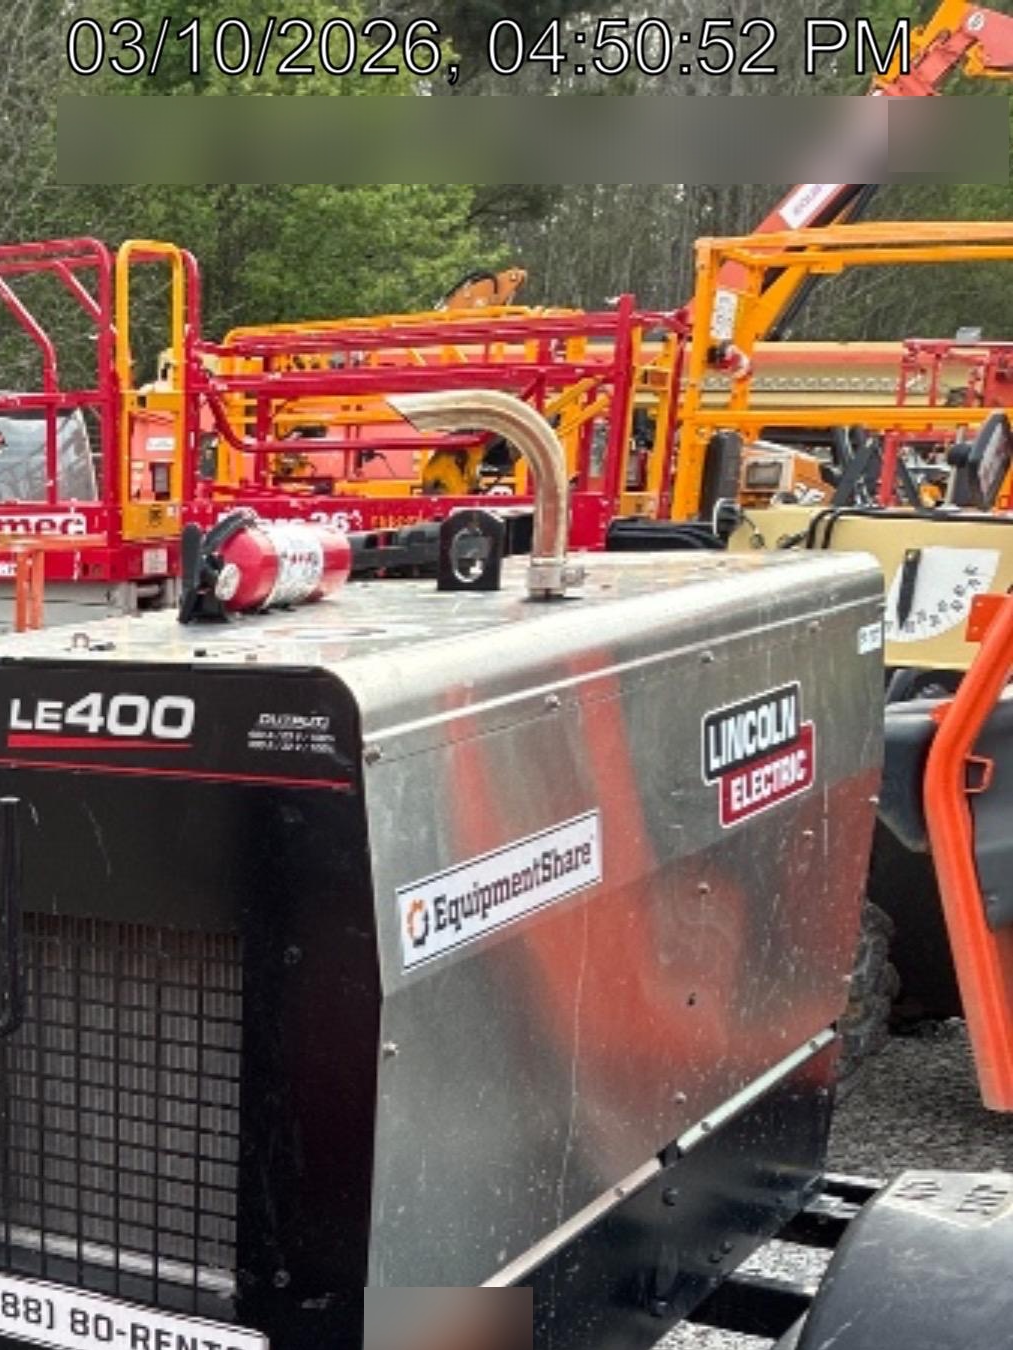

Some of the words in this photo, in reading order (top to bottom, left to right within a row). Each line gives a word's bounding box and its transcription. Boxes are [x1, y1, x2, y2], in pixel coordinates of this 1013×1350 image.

[10, 692, 195, 738] LE400
[709, 695, 796, 771] LINCOLN
[731, 750, 807, 813] ELECTRIC
[434, 842, 592, 932] EquipmentShare
